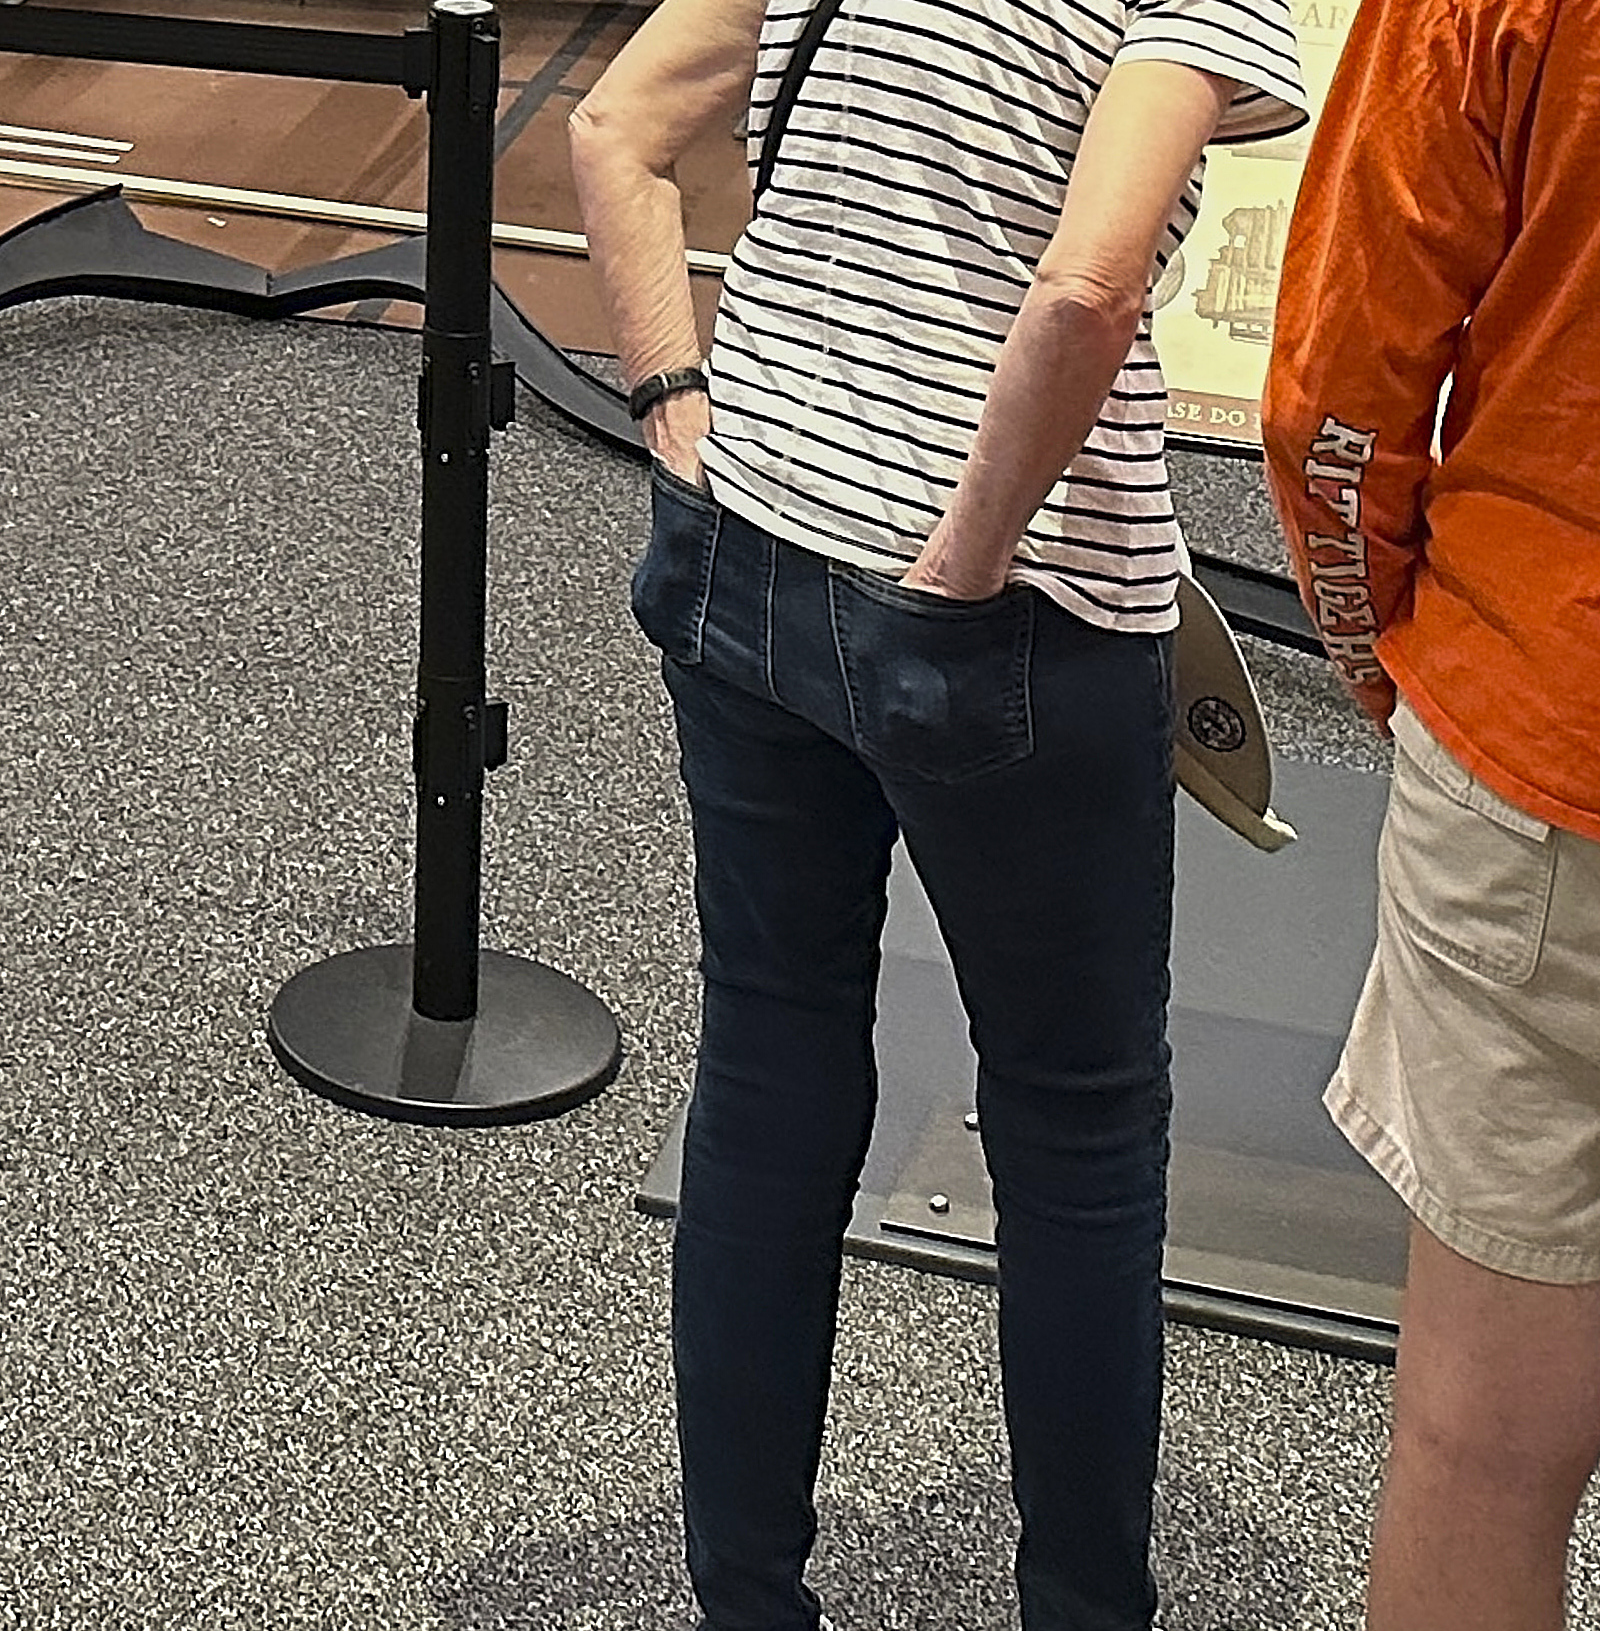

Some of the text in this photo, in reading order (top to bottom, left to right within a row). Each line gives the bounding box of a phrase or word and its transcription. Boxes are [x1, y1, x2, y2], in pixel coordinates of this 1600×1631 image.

[1209, 406, 1247, 427] DO
[1304, 416, 1381, 685] RIT TIGERS
